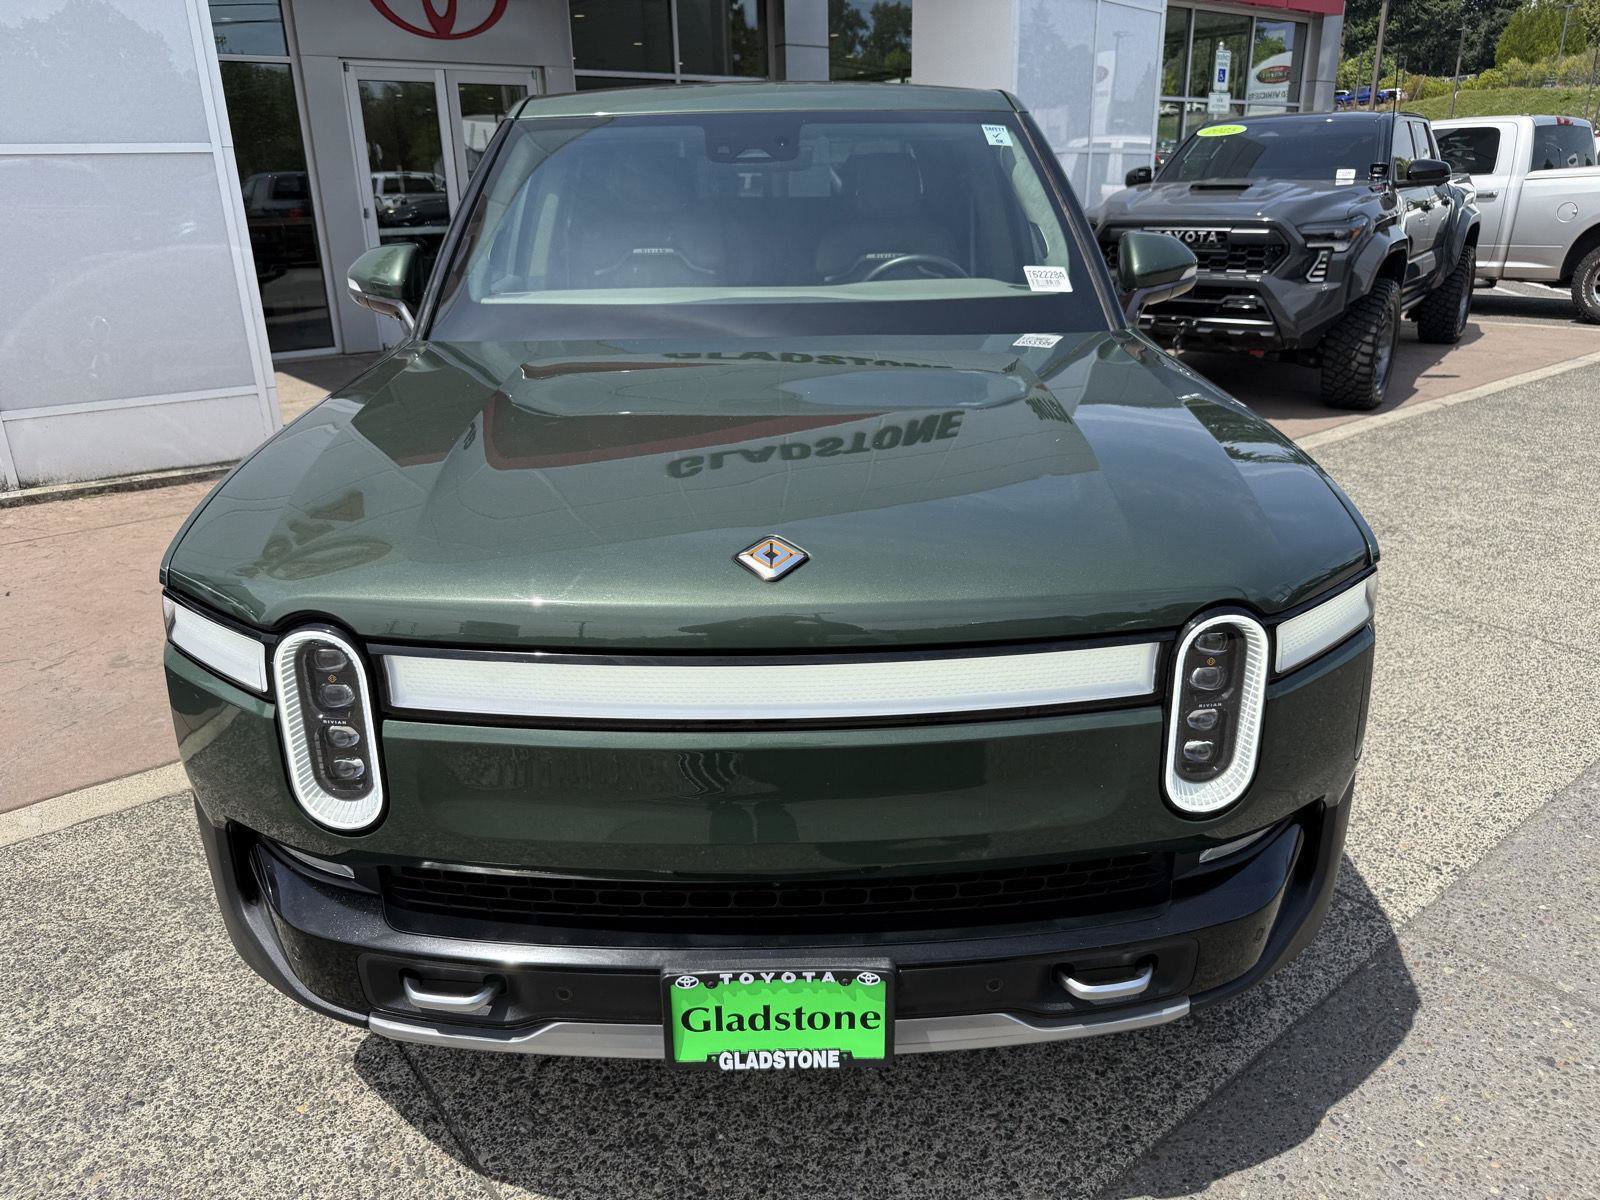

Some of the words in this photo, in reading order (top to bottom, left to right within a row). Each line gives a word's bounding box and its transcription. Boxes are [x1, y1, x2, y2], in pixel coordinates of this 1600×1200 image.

[719, 971, 836, 985] TOYOTA
[681, 1004, 881, 1032] Gladstone
[718, 1050, 840, 1070] GLADSTONE
